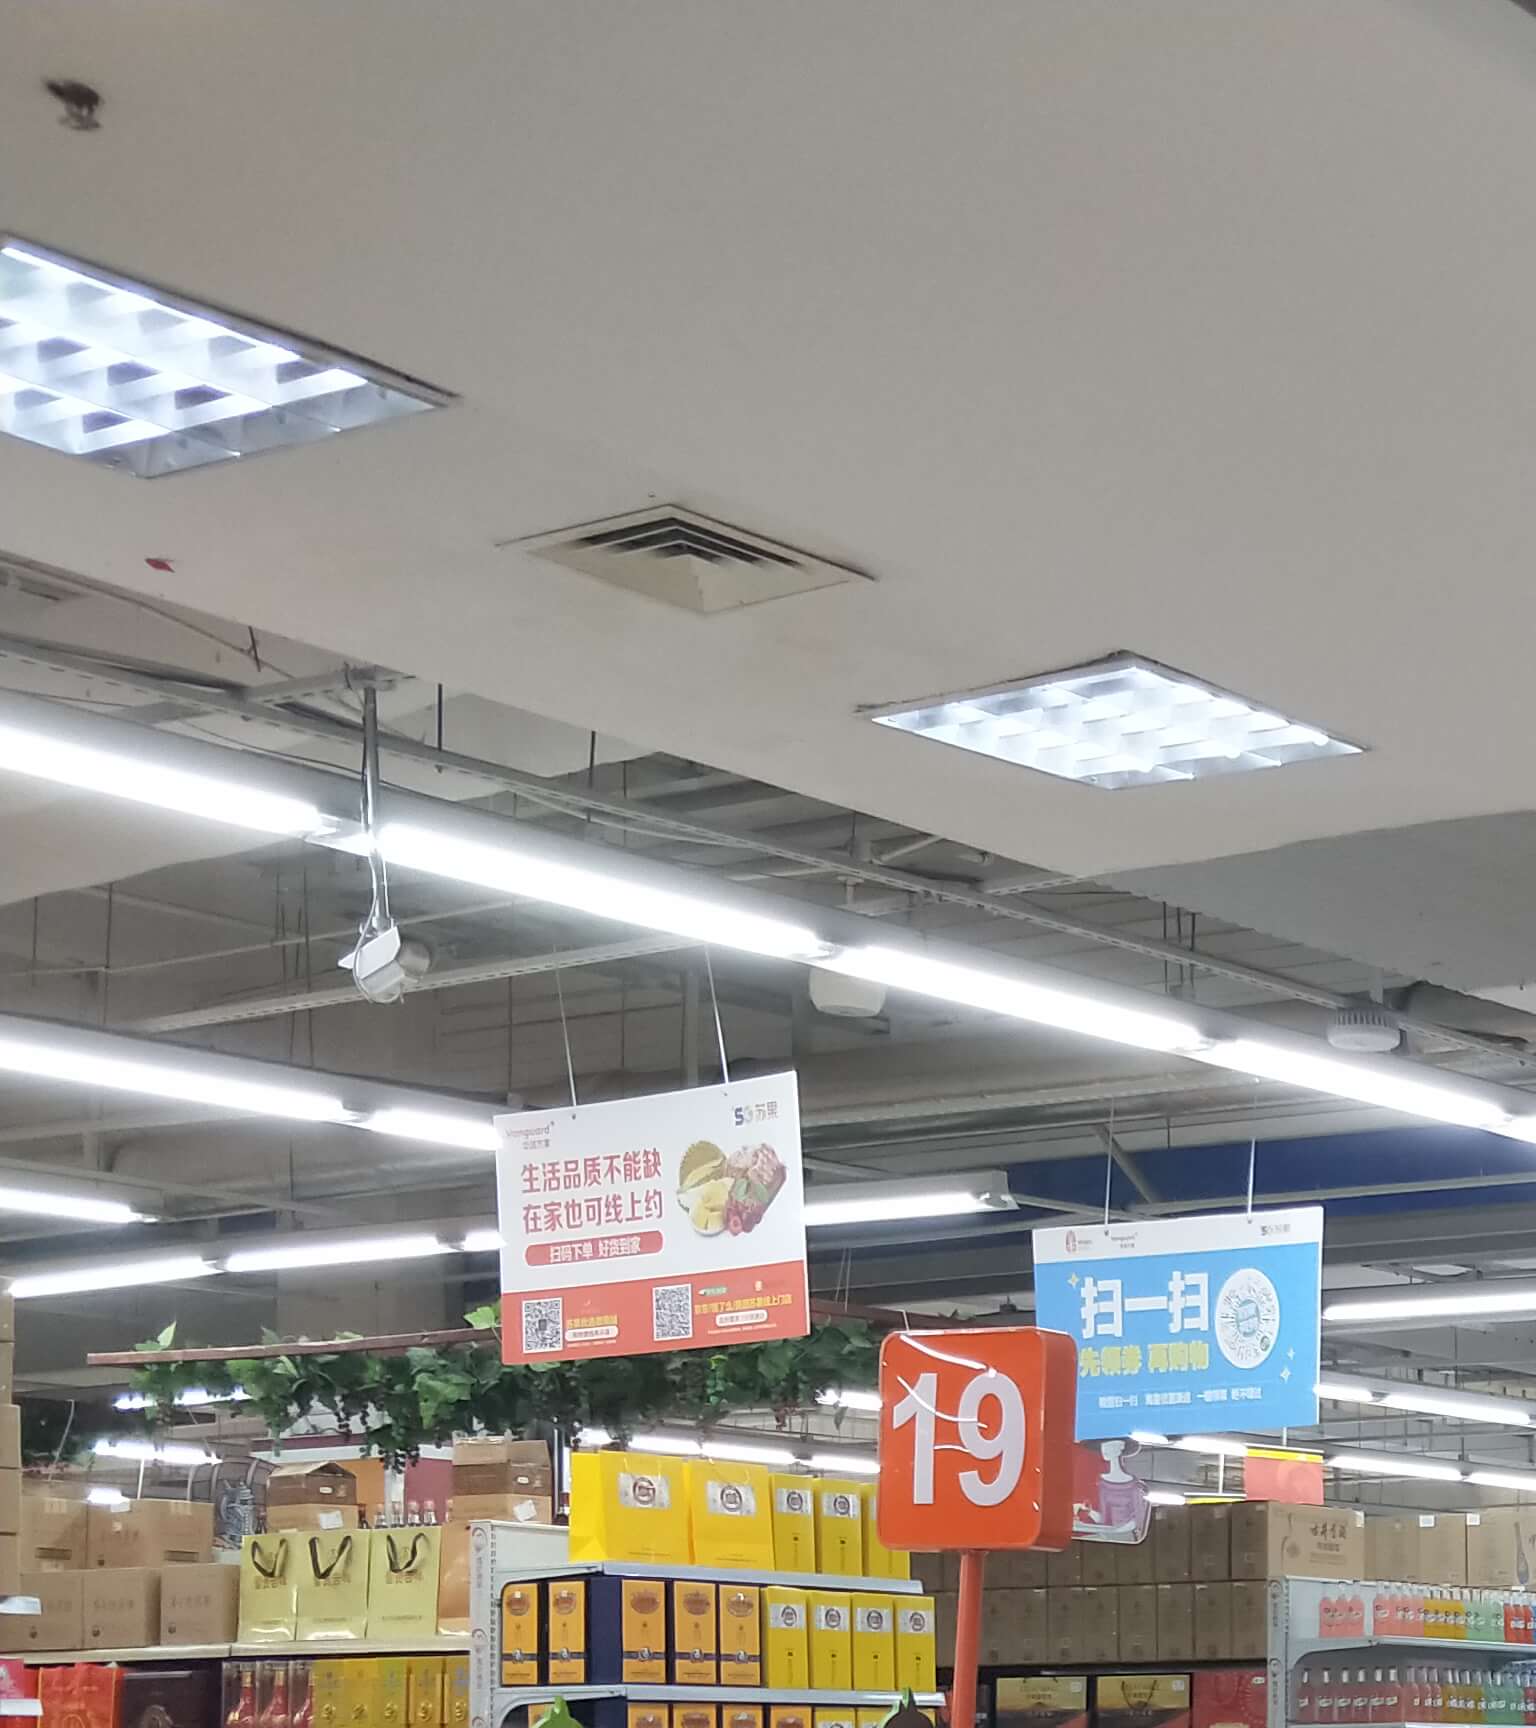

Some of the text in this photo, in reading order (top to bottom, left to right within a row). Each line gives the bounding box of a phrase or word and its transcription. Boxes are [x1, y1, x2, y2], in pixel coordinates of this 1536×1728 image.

[521, 1149, 663, 1194] 生活品质不能缺
[522, 1190, 664, 1235] 在家也可线上约
[549, 1242, 594, 1264] 扫码下单
[1080, 1270, 1209, 1339] 扫一扫
[891, 1371, 1026, 1507] 19
